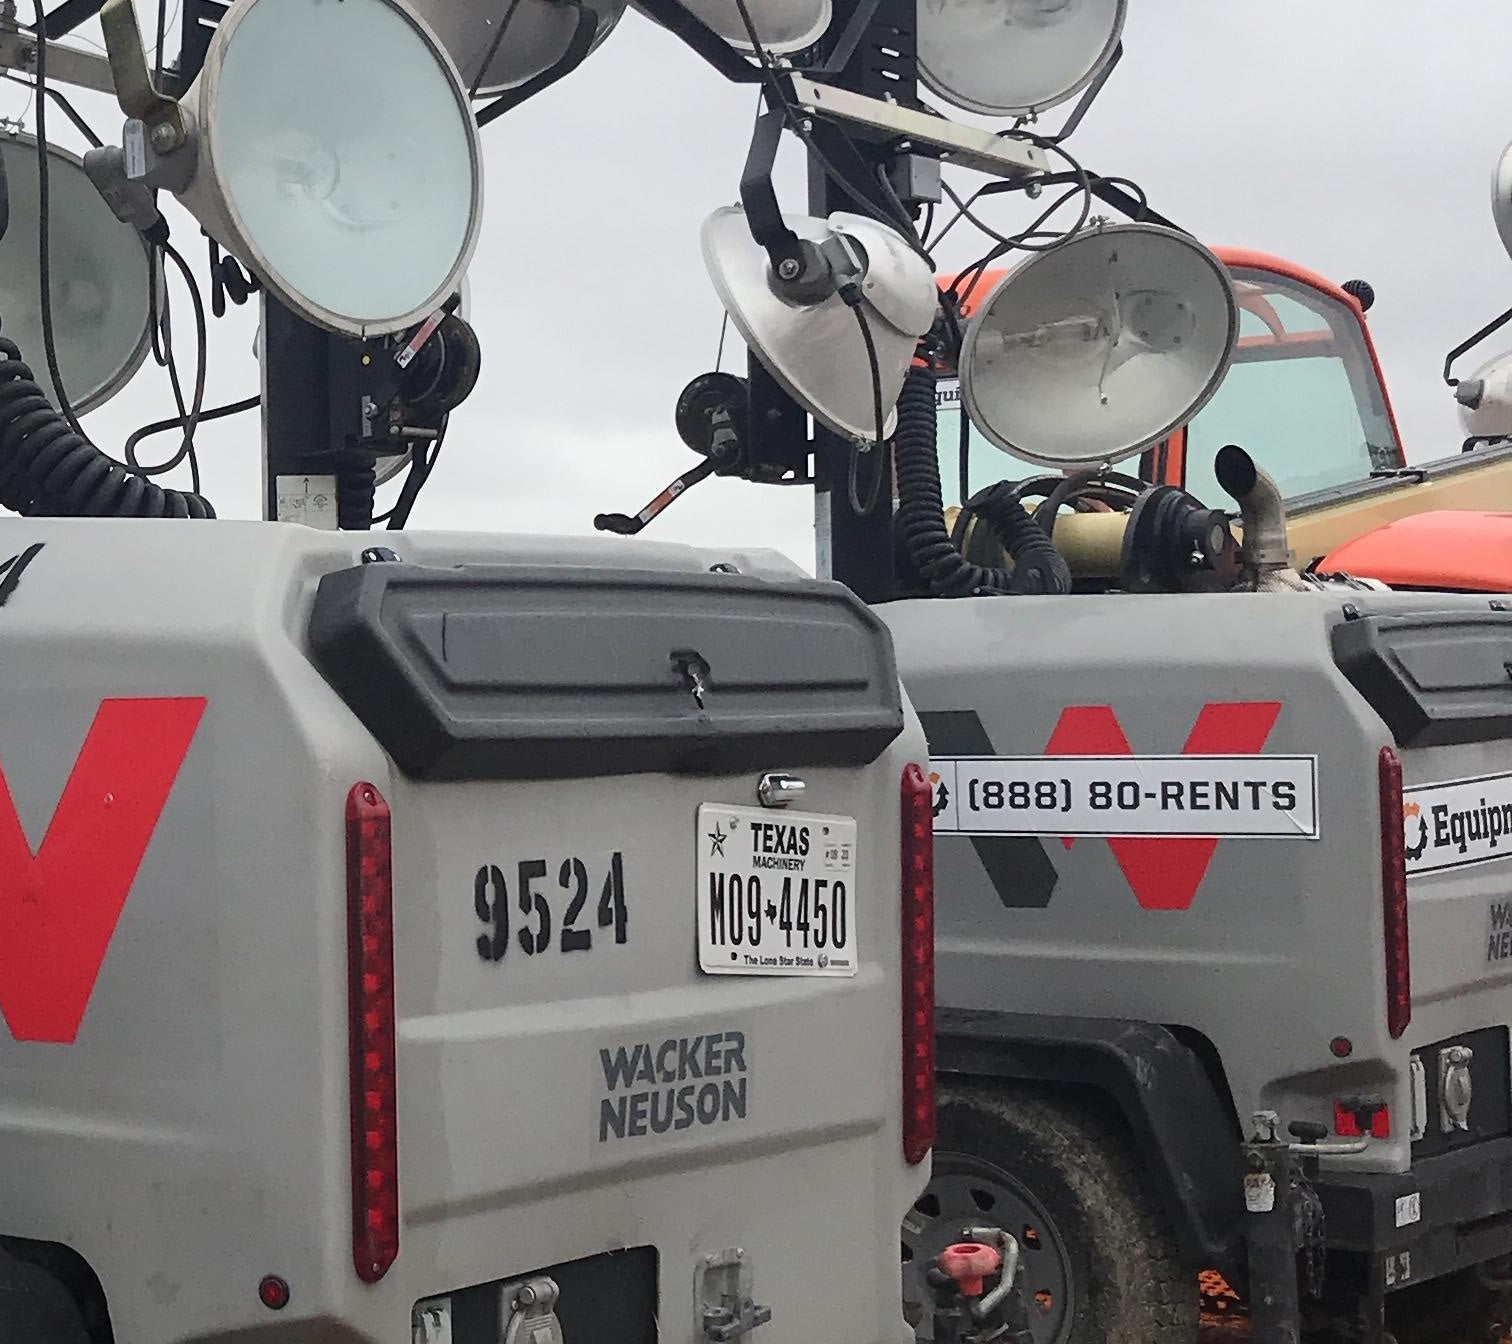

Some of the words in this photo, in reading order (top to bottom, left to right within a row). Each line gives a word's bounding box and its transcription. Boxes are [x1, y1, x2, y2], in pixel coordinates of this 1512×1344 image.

[969, 778, 1072, 812] (888)
[1088, 780, 1297, 812] 80-RENTS
[750, 822, 810, 856] TEXAS
[752, 855, 806, 871] MACHINERY
[474, 852, 628, 962] 9524
[744, 955, 758, 965] The
[759, 955, 777, 966] Lone
[779, 956, 794, 966] Star
[795, 956, 814, 967] State
[599, 1031, 747, 1091] WACKER
[599, 1077, 747, 1142] NEUSON
